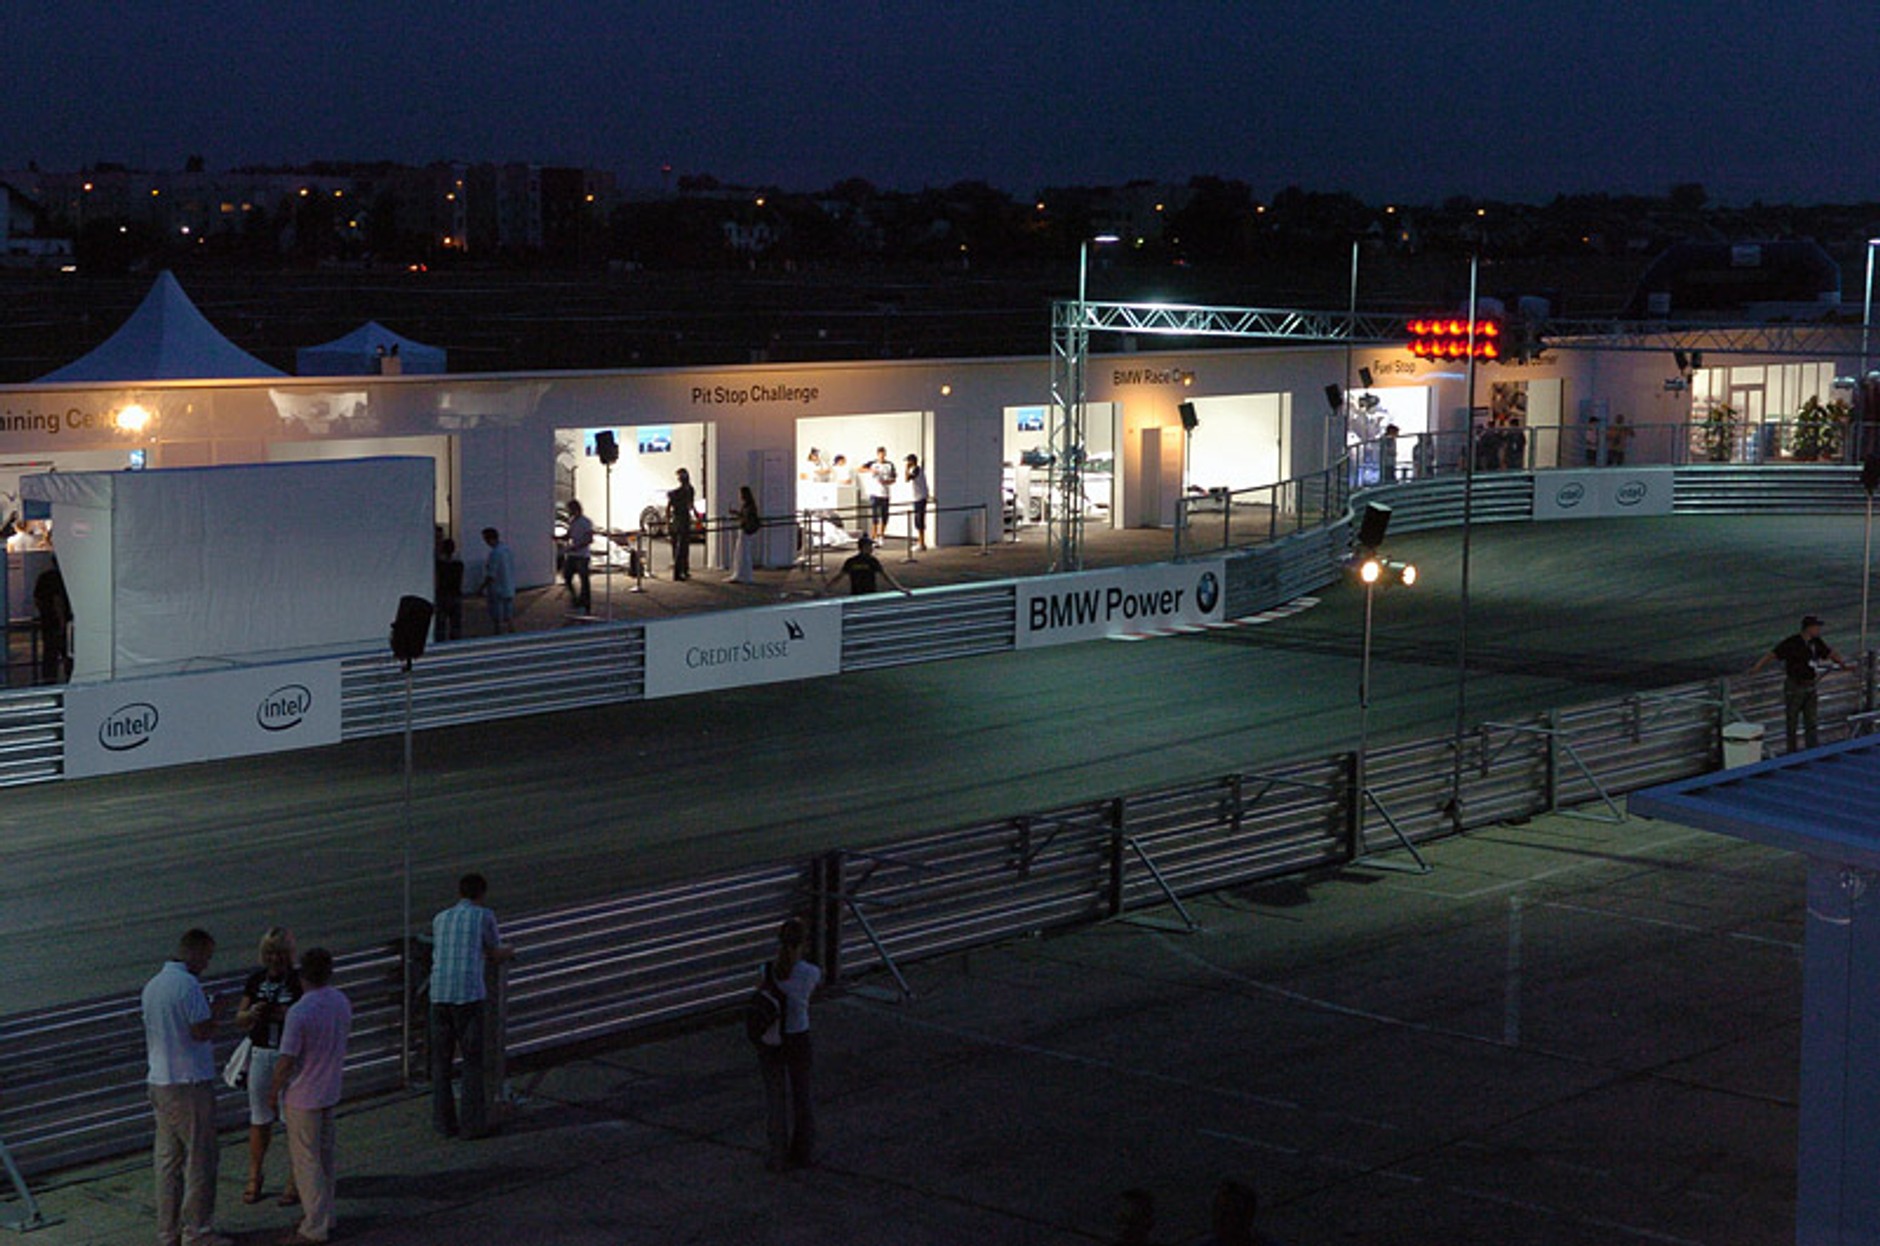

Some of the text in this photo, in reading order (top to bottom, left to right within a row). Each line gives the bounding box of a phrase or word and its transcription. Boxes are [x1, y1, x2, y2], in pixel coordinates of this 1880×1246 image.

[1114, 370, 1141, 385] BMW
[1144, 370, 1169, 384] Race
[1395, 360, 1415, 373] Stop
[692, 384, 819, 405] Pit Stop Challenge
[1030, 587, 1184, 631] BMW Power
[686, 638, 789, 669] CREDIT SUISSE
[265, 695, 304, 717] intel
[107, 714, 151, 737] intel
